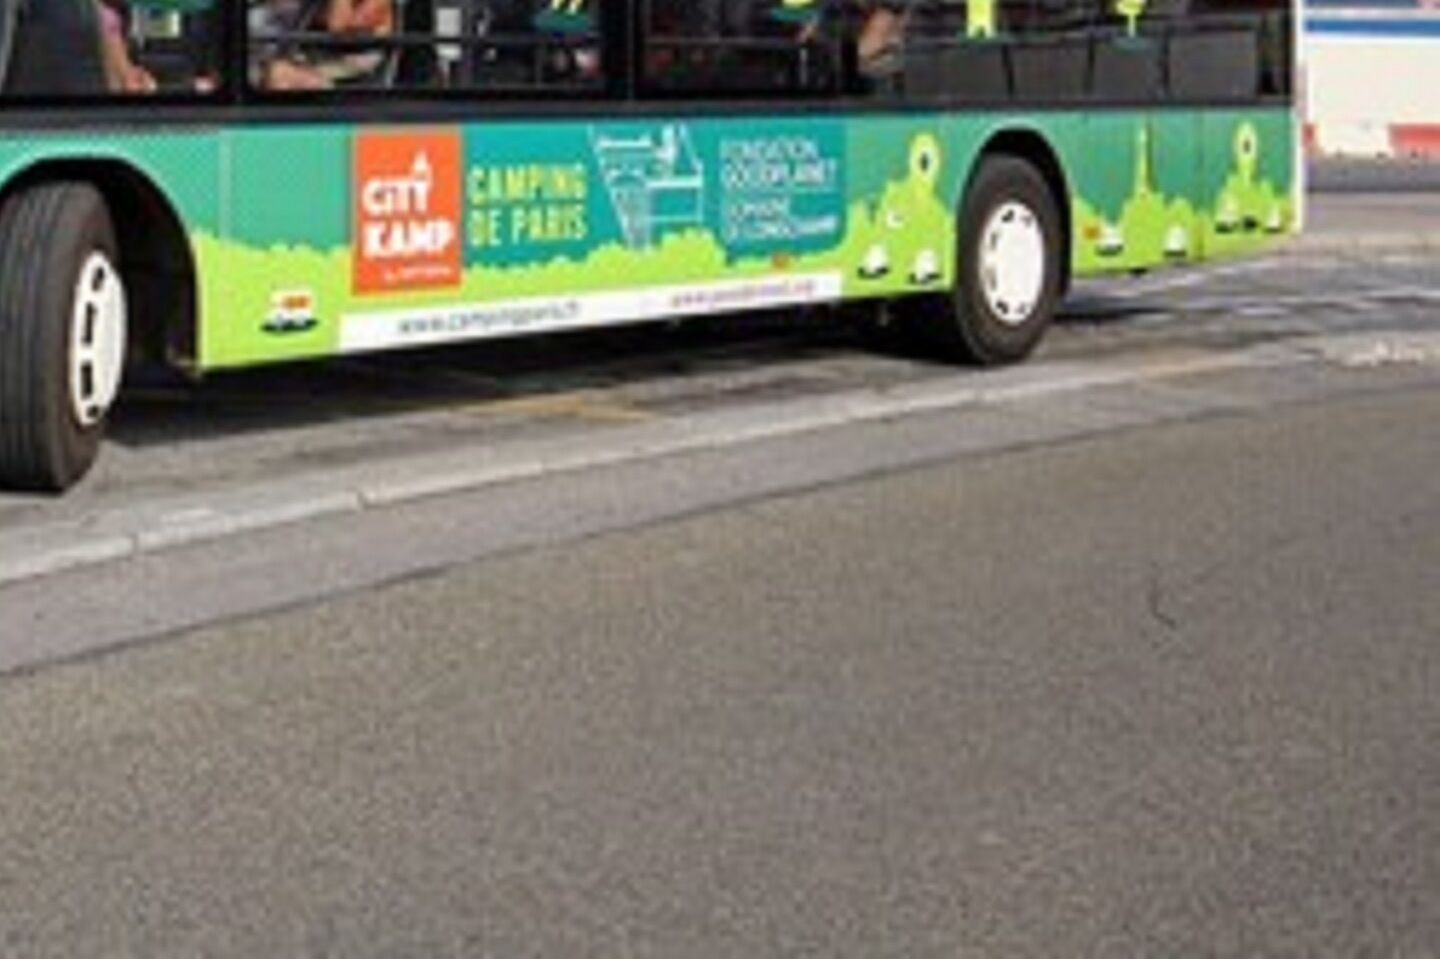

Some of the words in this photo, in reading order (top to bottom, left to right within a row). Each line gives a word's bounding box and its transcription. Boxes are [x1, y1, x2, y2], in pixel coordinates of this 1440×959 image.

[362, 172, 430, 215] CITY
[468, 163, 586, 206] CAMPING
[362, 219, 455, 258] KAMP
[468, 208, 504, 247] DE
[511, 203, 588, 245] PARIS
